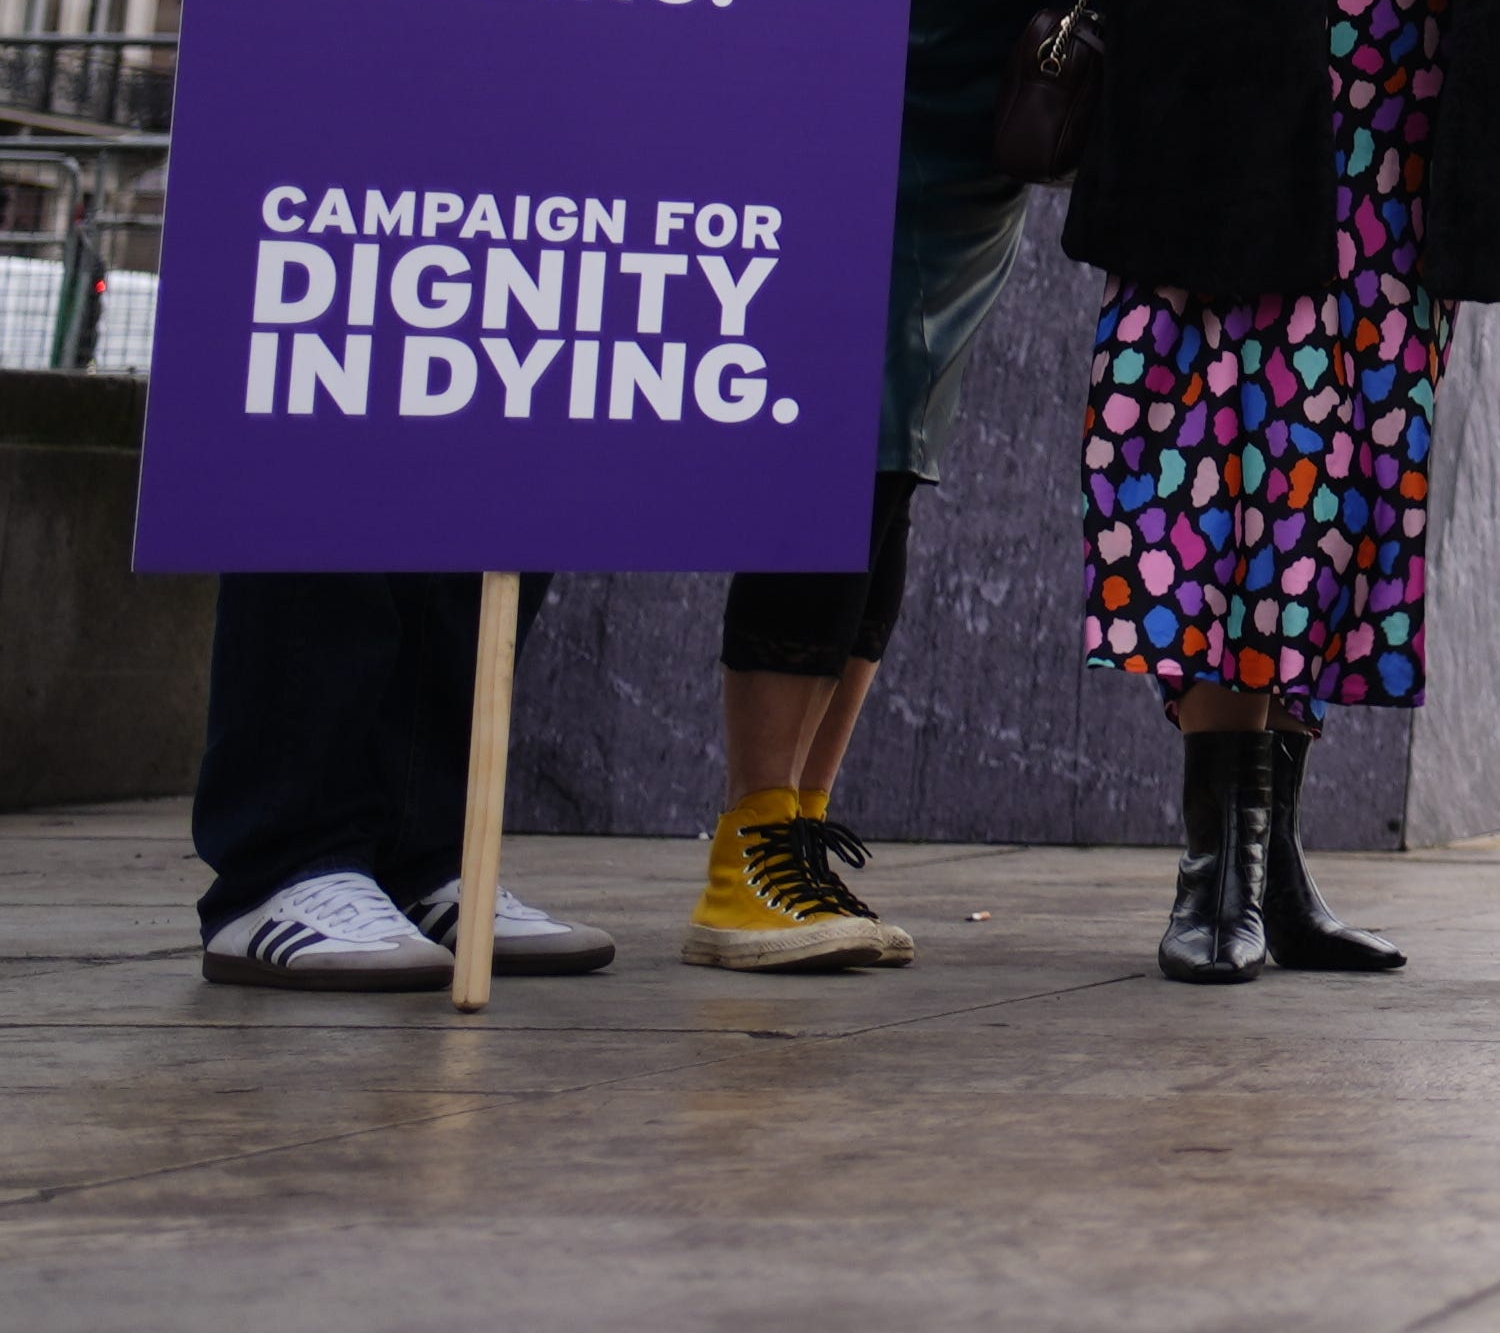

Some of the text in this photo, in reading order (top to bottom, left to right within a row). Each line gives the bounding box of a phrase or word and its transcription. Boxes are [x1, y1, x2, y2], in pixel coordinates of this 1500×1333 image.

[263, 187, 781, 249] CAMPAIGN FOR
[254, 241, 778, 335] DIGNITY
[246, 333, 798, 423] IN DYING.
